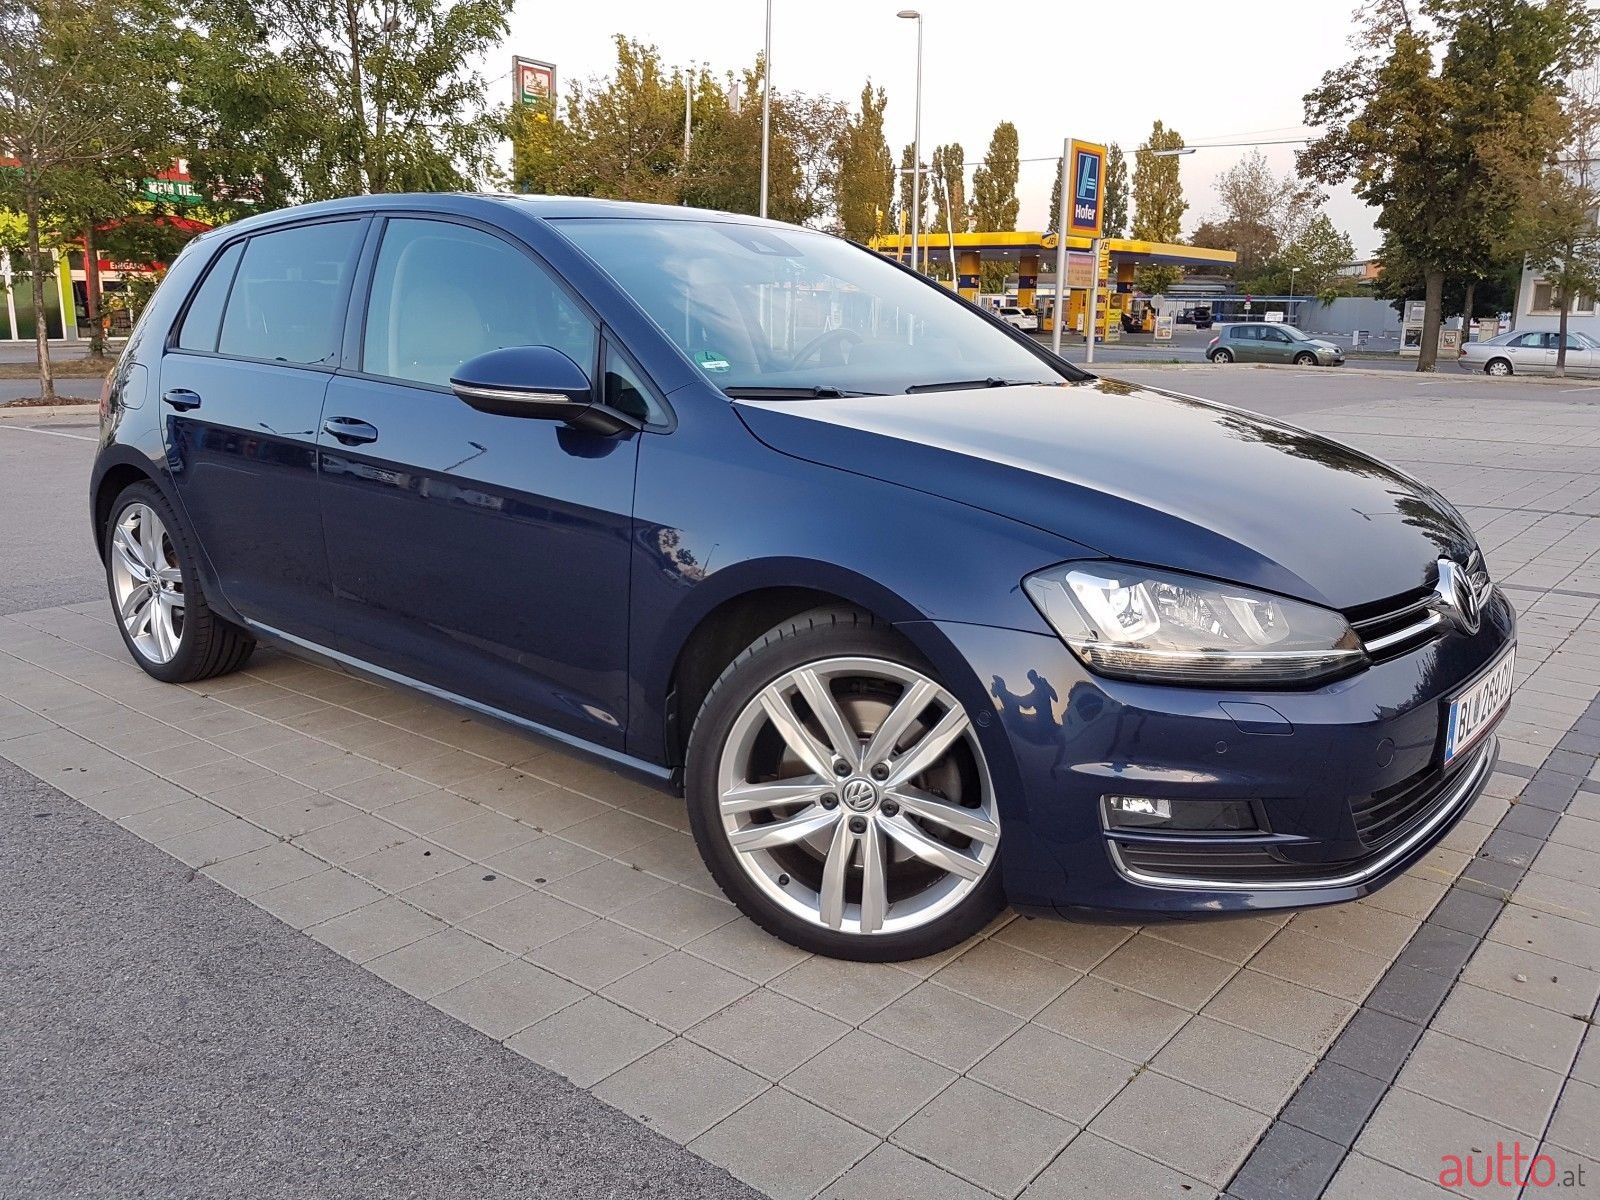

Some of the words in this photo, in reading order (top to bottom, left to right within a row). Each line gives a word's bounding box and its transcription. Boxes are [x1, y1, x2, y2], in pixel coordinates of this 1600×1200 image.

[177, 183, 199, 197] TIE
[1075, 203, 1096, 221] Hofer
[1046, 237, 1057, 245] JET
[1457, 697, 1472, 743] BL
